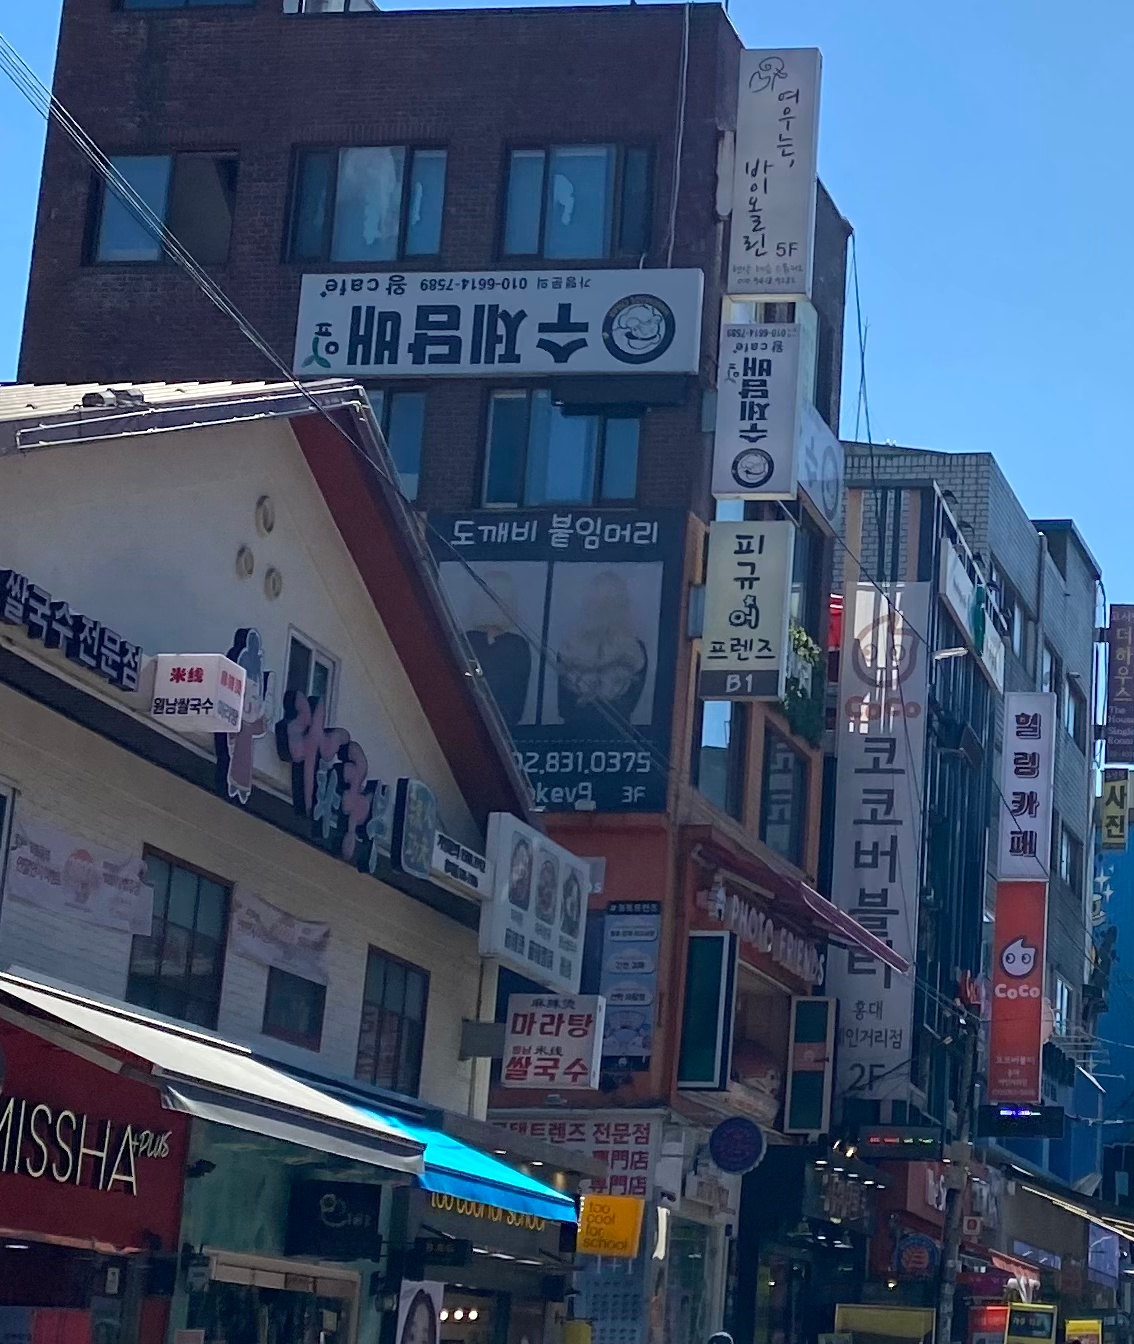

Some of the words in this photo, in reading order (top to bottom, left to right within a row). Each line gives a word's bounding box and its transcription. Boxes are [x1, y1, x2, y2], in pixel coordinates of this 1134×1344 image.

[775, 241, 799, 257] 5F
[347, 303, 590, 367] 수제담배
[738, 357, 772, 444] 수제담배
[451, 519, 538, 546] 도깨비
[728, 533, 766, 630] 피규어
[3, 570, 144, 693] 쌀국수전문점
[706, 637, 777, 661] 프렌즈
[725, 674, 754, 694] B1
[622, 786, 647, 803] 3F
[1008, 712, 1042, 858] 힐링카페
[1104, 785, 1127, 839] 사진
[994, 983, 1040, 1000] CoCo
[852, 999, 883, 1021] 홍대
[511, 1012, 594, 1038] 마라탕
[505, 1056, 589, 1083] 쌀국수
[848, 1063, 885, 1091] 2F
[492, 1122, 586, 1144] 택트렌즈
[593, 1122, 651, 1145] 전문점
[586, 1213, 616, 1226] cool
[583, 1236, 629, 1251] school
